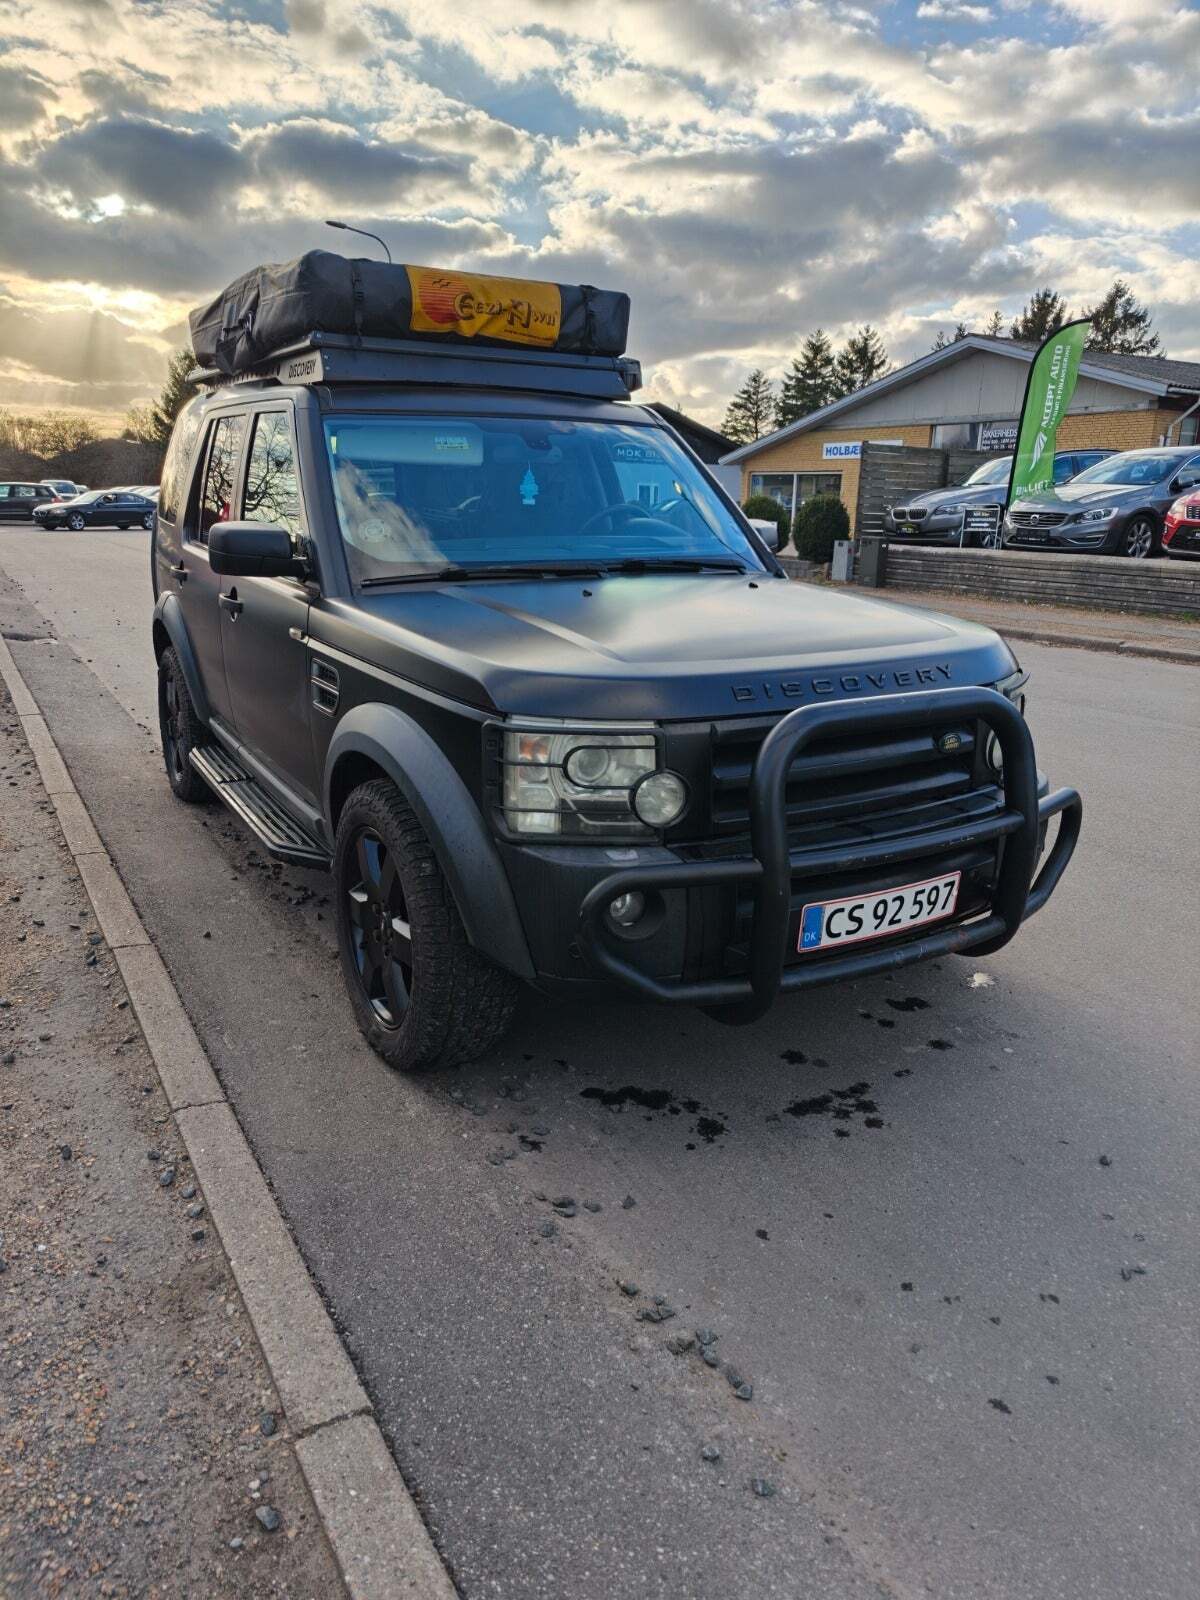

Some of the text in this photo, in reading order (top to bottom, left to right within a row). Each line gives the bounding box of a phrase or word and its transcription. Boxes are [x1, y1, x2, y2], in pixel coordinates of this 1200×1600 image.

[288, 359, 317, 379] DISCOVERY
[1041, 345, 1064, 428] ACCEPT AUTO
[825, 445, 862, 457] HOLBÆ
[731, 664, 953, 701] DISCOVERY
[825, 880, 956, 939] CS 92 597
[804, 931, 817, 942] DK
